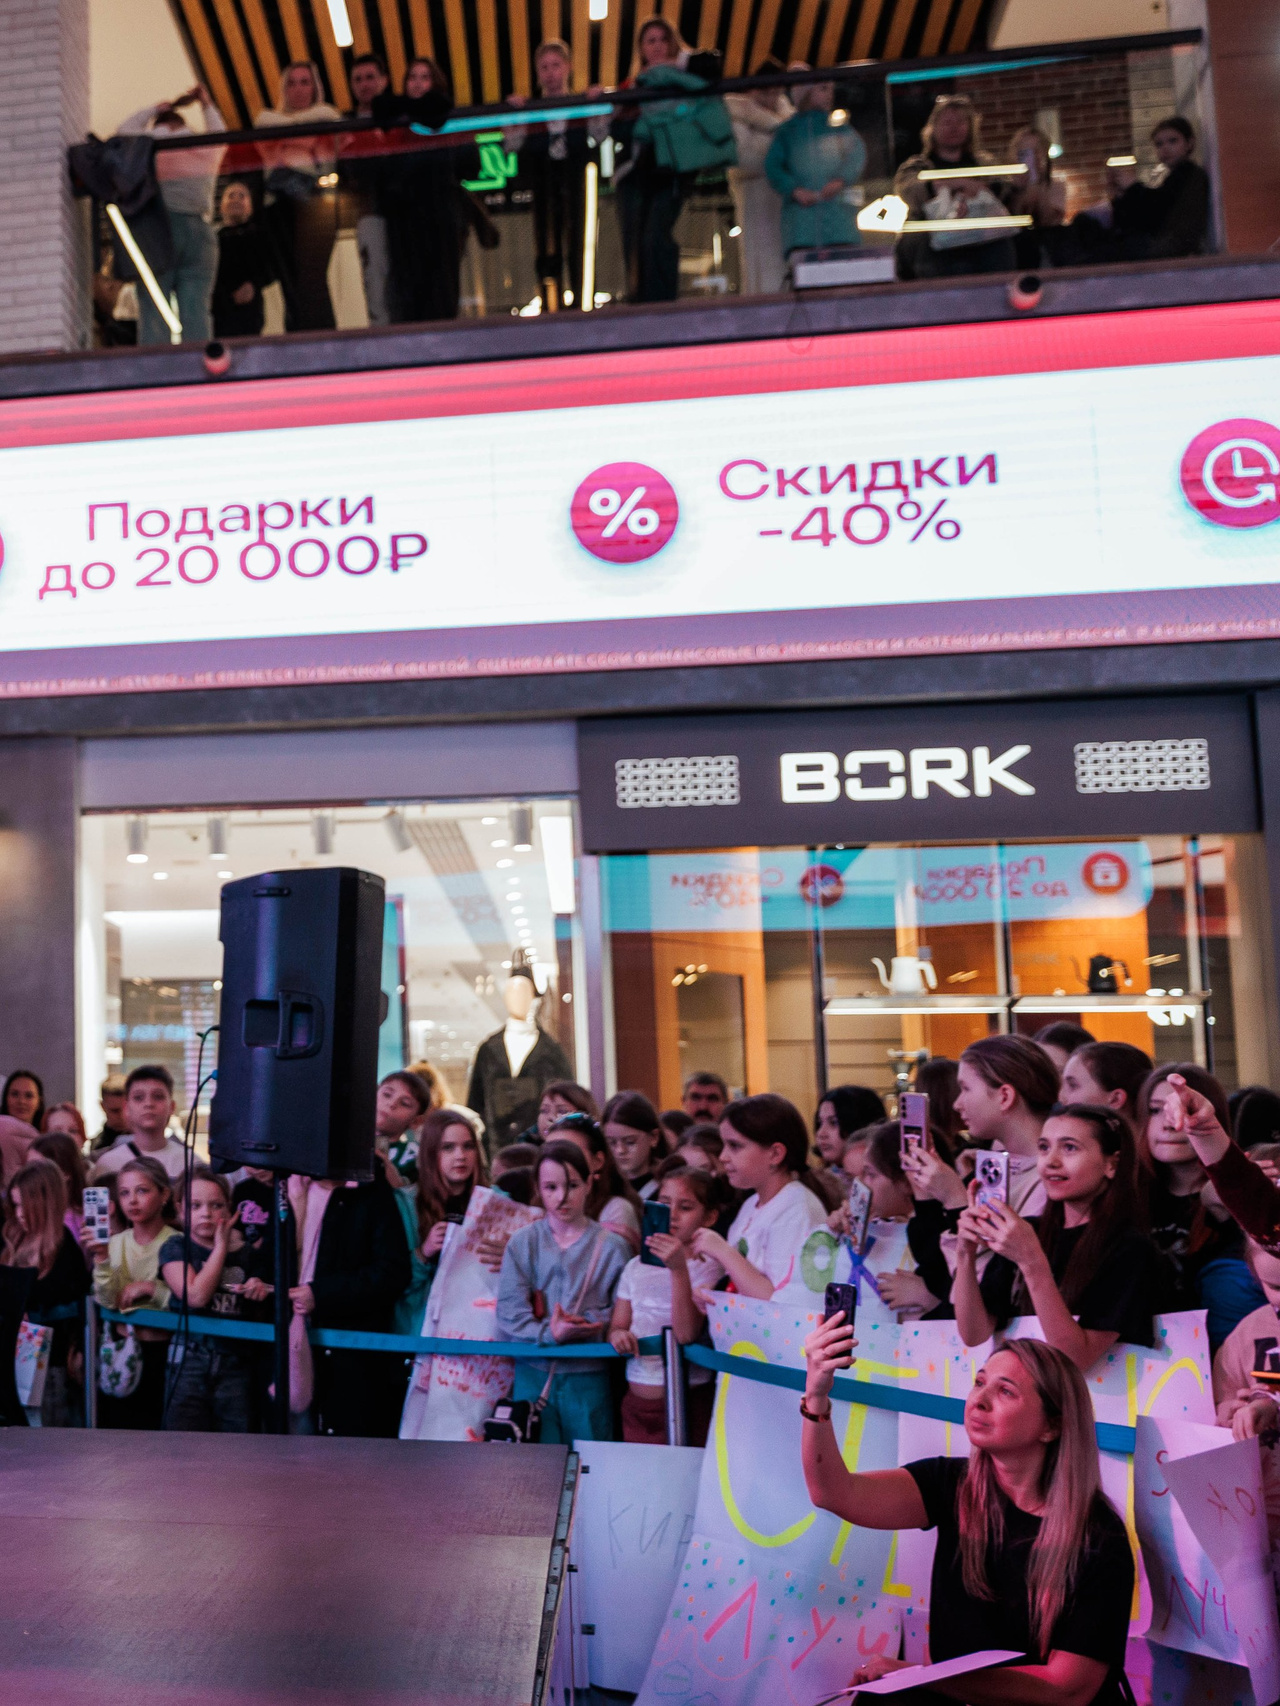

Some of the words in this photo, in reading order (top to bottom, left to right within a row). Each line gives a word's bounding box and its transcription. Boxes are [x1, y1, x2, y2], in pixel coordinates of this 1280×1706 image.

[719, 453, 999, 504] Скидки
[88, 495, 375, 545] Подарки
[758, 498, 961, 547] -40%
[37, 560, 117, 601] до
[135, 545, 220, 588] 20
[780, 744, 1036, 805] BORK
